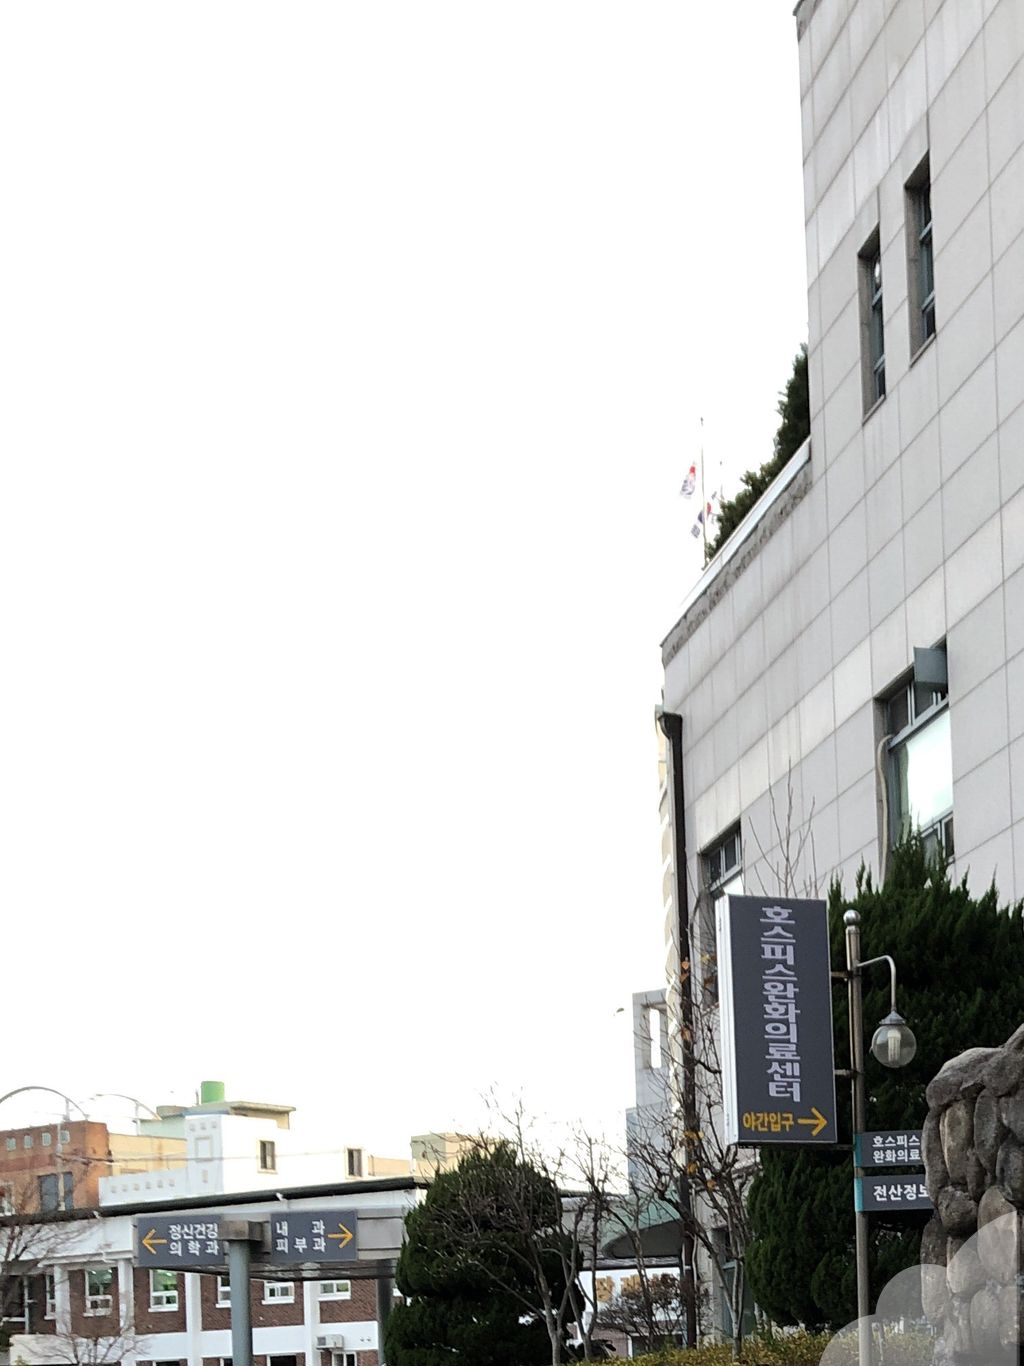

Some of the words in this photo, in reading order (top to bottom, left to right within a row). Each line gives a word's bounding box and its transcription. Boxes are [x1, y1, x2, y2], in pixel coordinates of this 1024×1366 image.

[760, 905, 801, 1102] 호스피스완화의료센터
[742, 1111, 794, 1131] 야간입구
[872, 1134, 920, 1147] 호스피스
[873, 1149, 921, 1163] 완화의료
